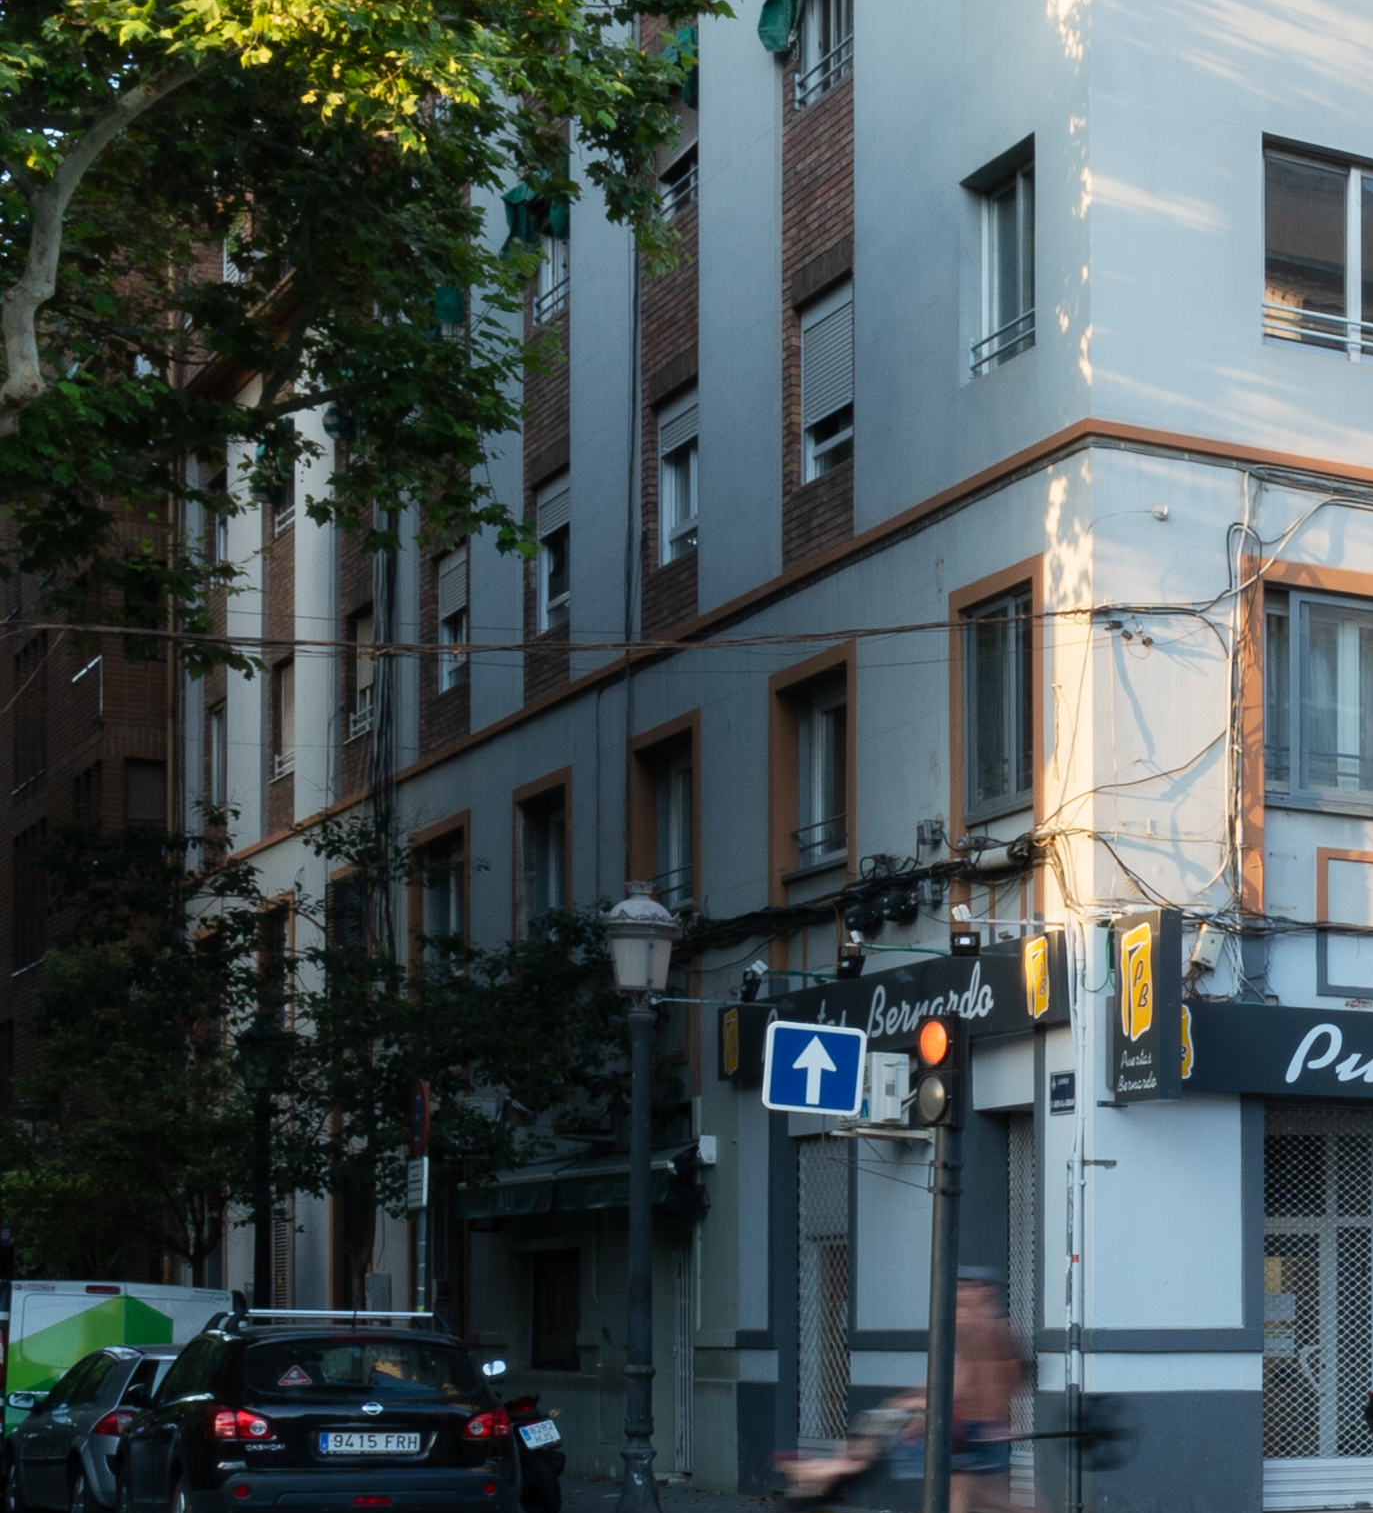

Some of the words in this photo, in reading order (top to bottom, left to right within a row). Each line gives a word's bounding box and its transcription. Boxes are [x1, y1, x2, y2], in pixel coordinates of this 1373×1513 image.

[866, 960, 994, 1039] Bernardo
[1137, 982, 1149, 1008] B
[1120, 1049, 1152, 1070] Puertas
[1117, 1072, 1157, 1092] Bernardo
[333, 1434, 377, 1448] 9415
[385, 1435, 418, 1449] FRH
